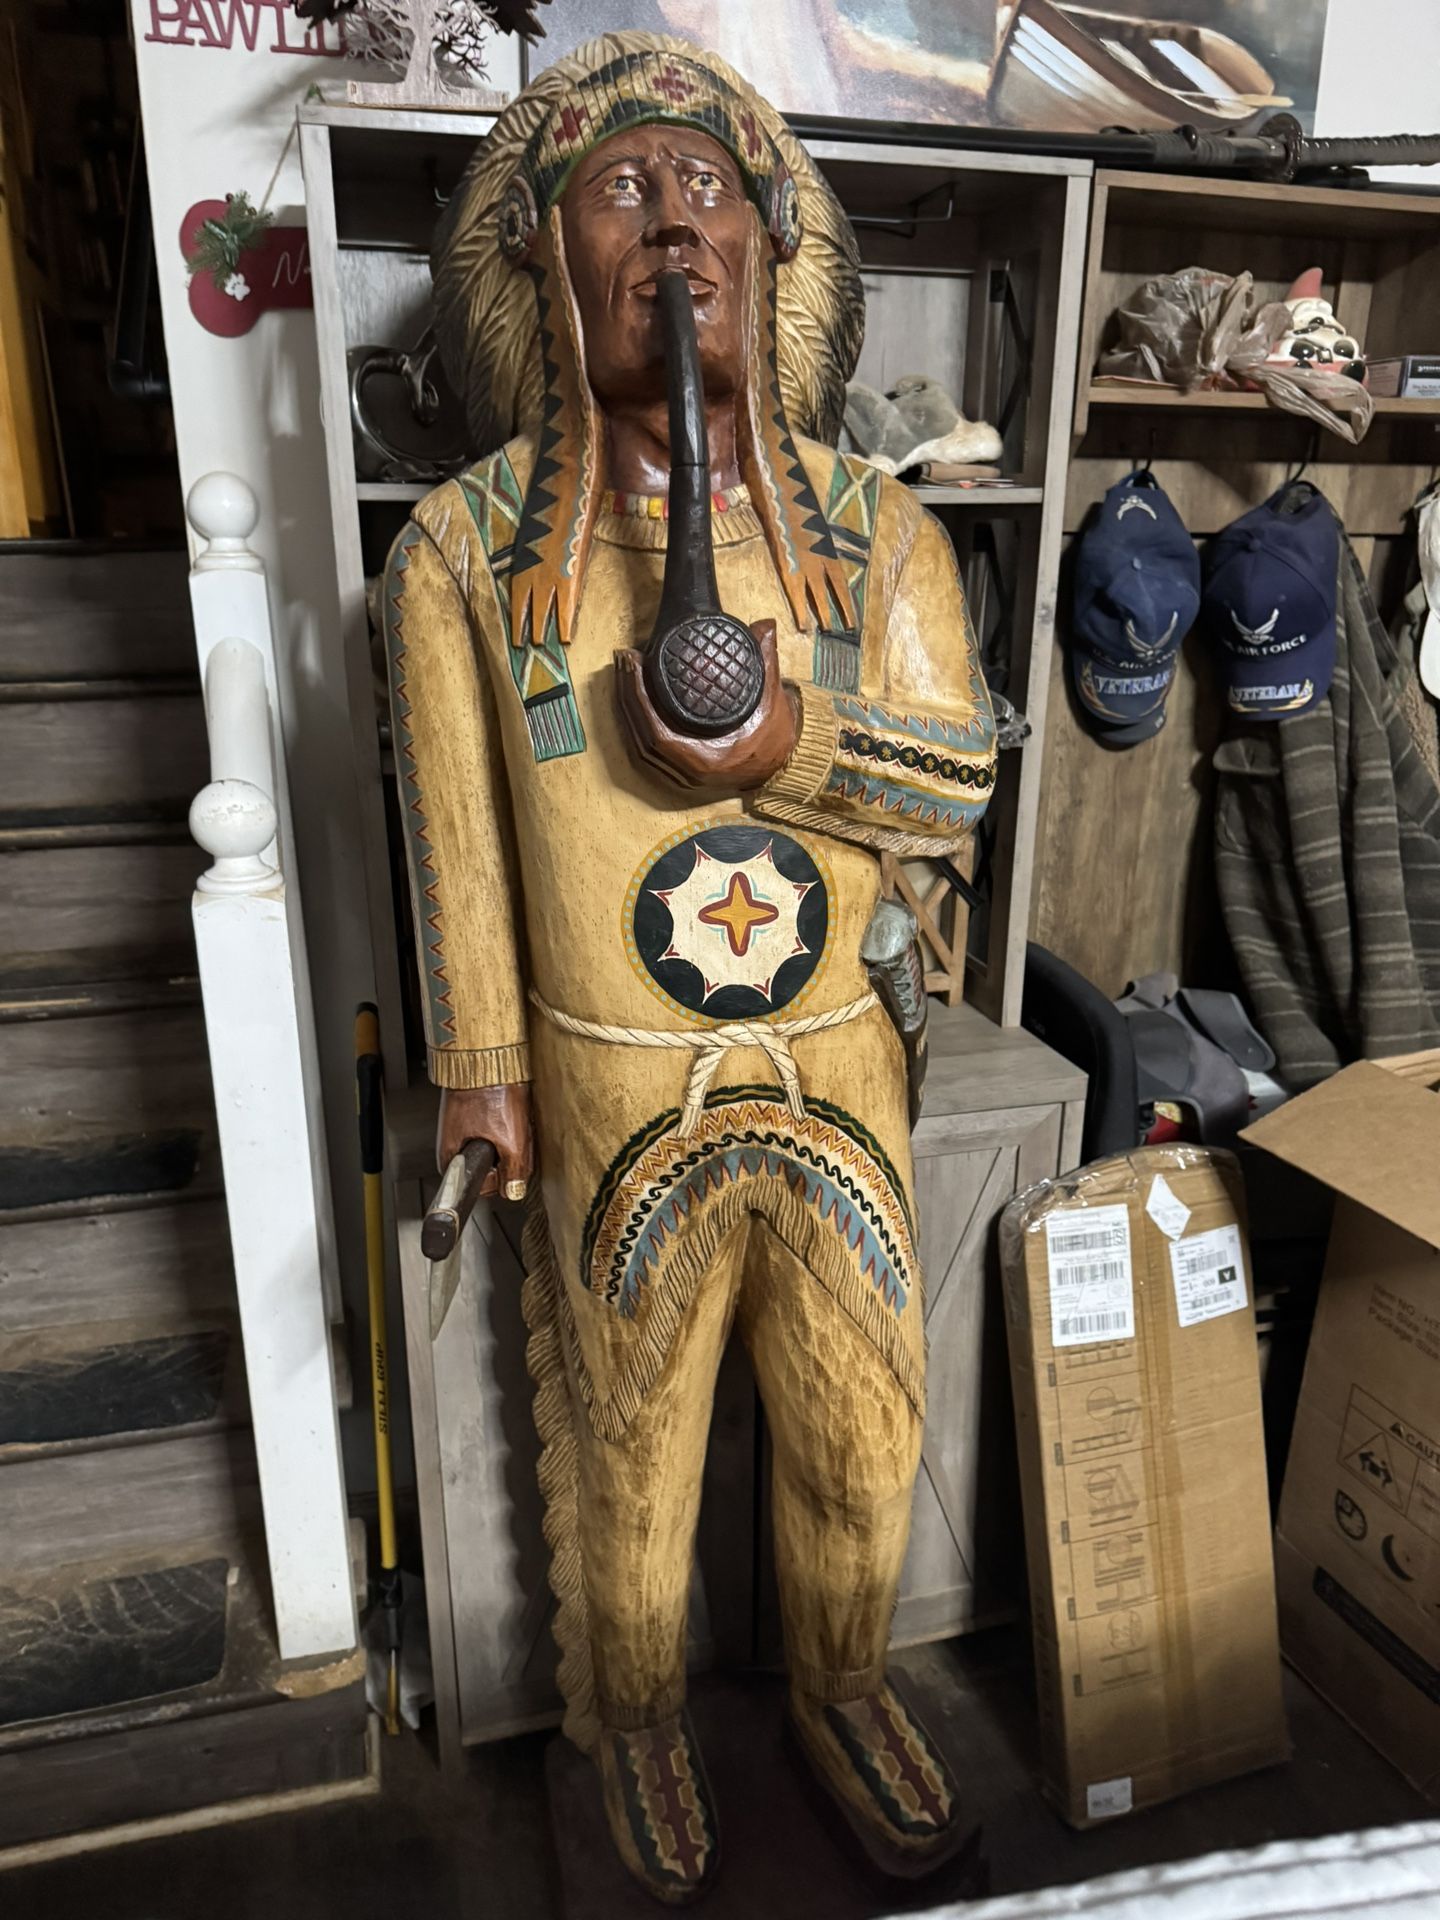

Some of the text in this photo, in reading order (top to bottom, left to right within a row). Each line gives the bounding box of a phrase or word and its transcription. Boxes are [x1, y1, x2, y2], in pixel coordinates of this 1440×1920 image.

[1262, 634, 1307, 656] FORCE
[1094, 671, 1171, 694] VETERAN
[1233, 683, 1302, 703] VETERAN
